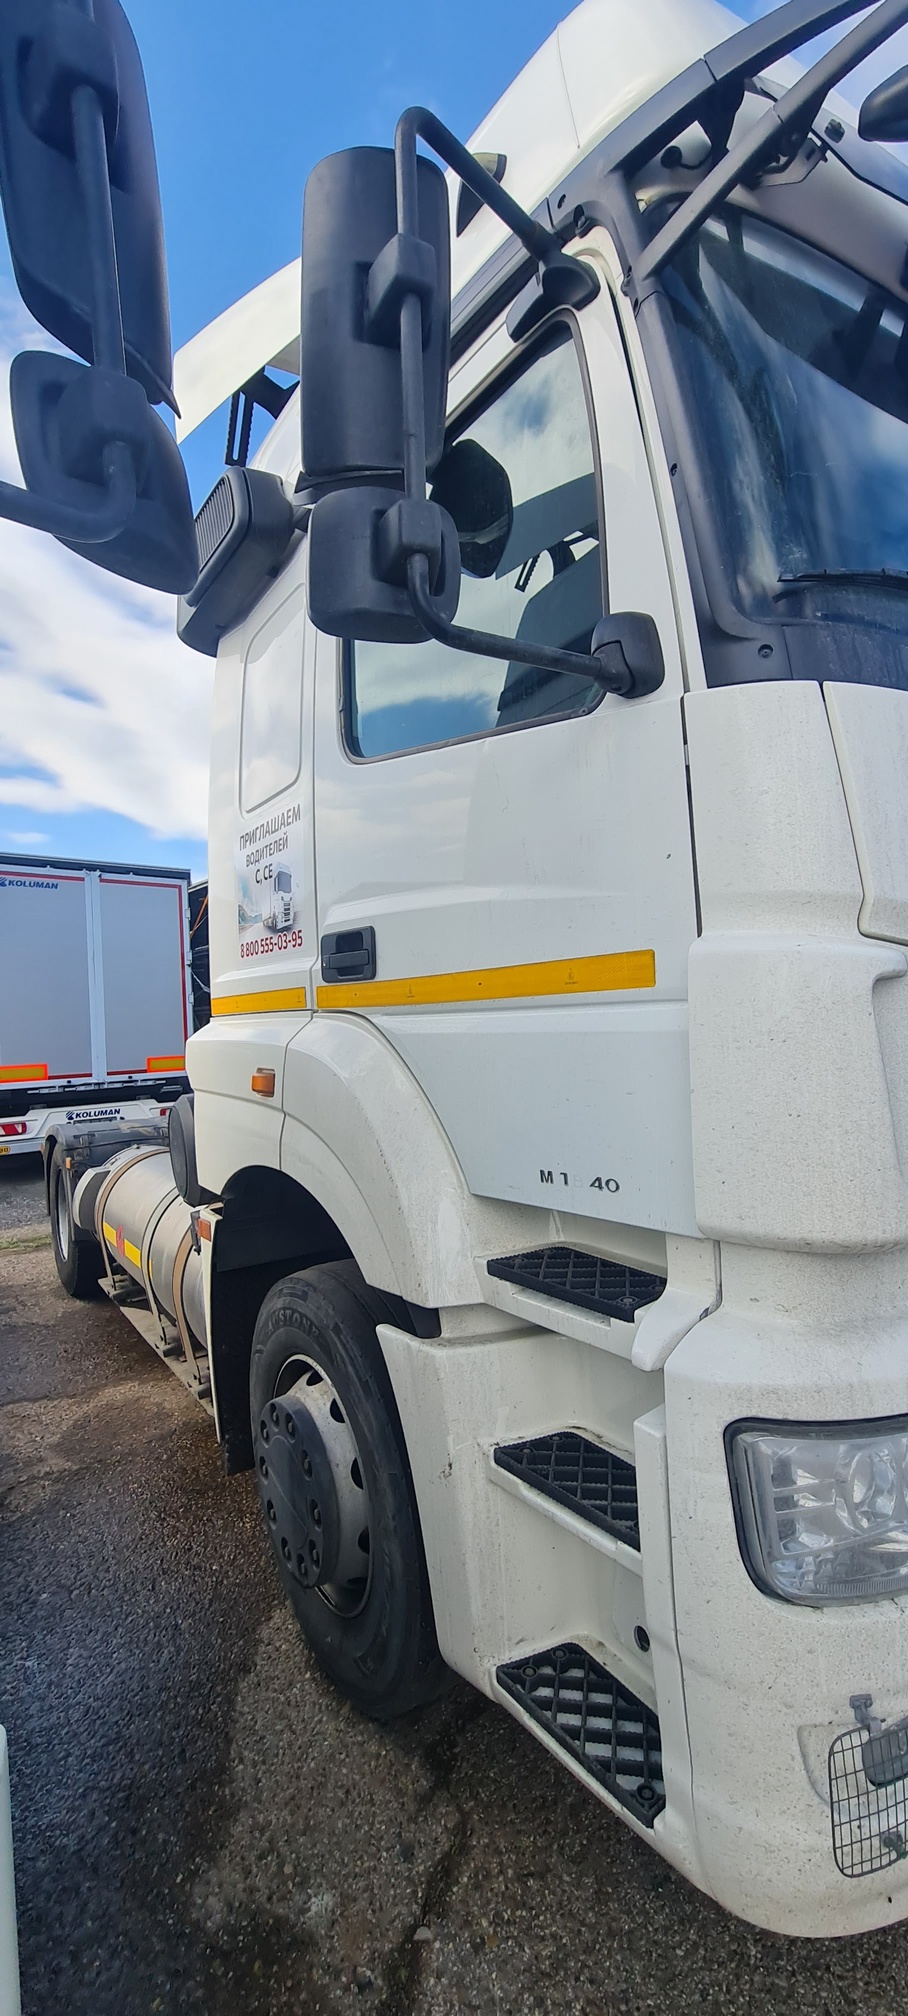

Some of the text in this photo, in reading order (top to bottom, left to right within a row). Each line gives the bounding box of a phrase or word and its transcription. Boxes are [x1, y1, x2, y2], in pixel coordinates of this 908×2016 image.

[239, 803, 301, 851] ПРИГЛАШАЕМ
[245, 830, 289, 868] ВОДИТЕЛЕЙ
[8, 879, 59, 890] KOLUMAN
[260, 929, 303, 955] 555-03-95
[75, 1108, 121, 1119] KOLUMAN
